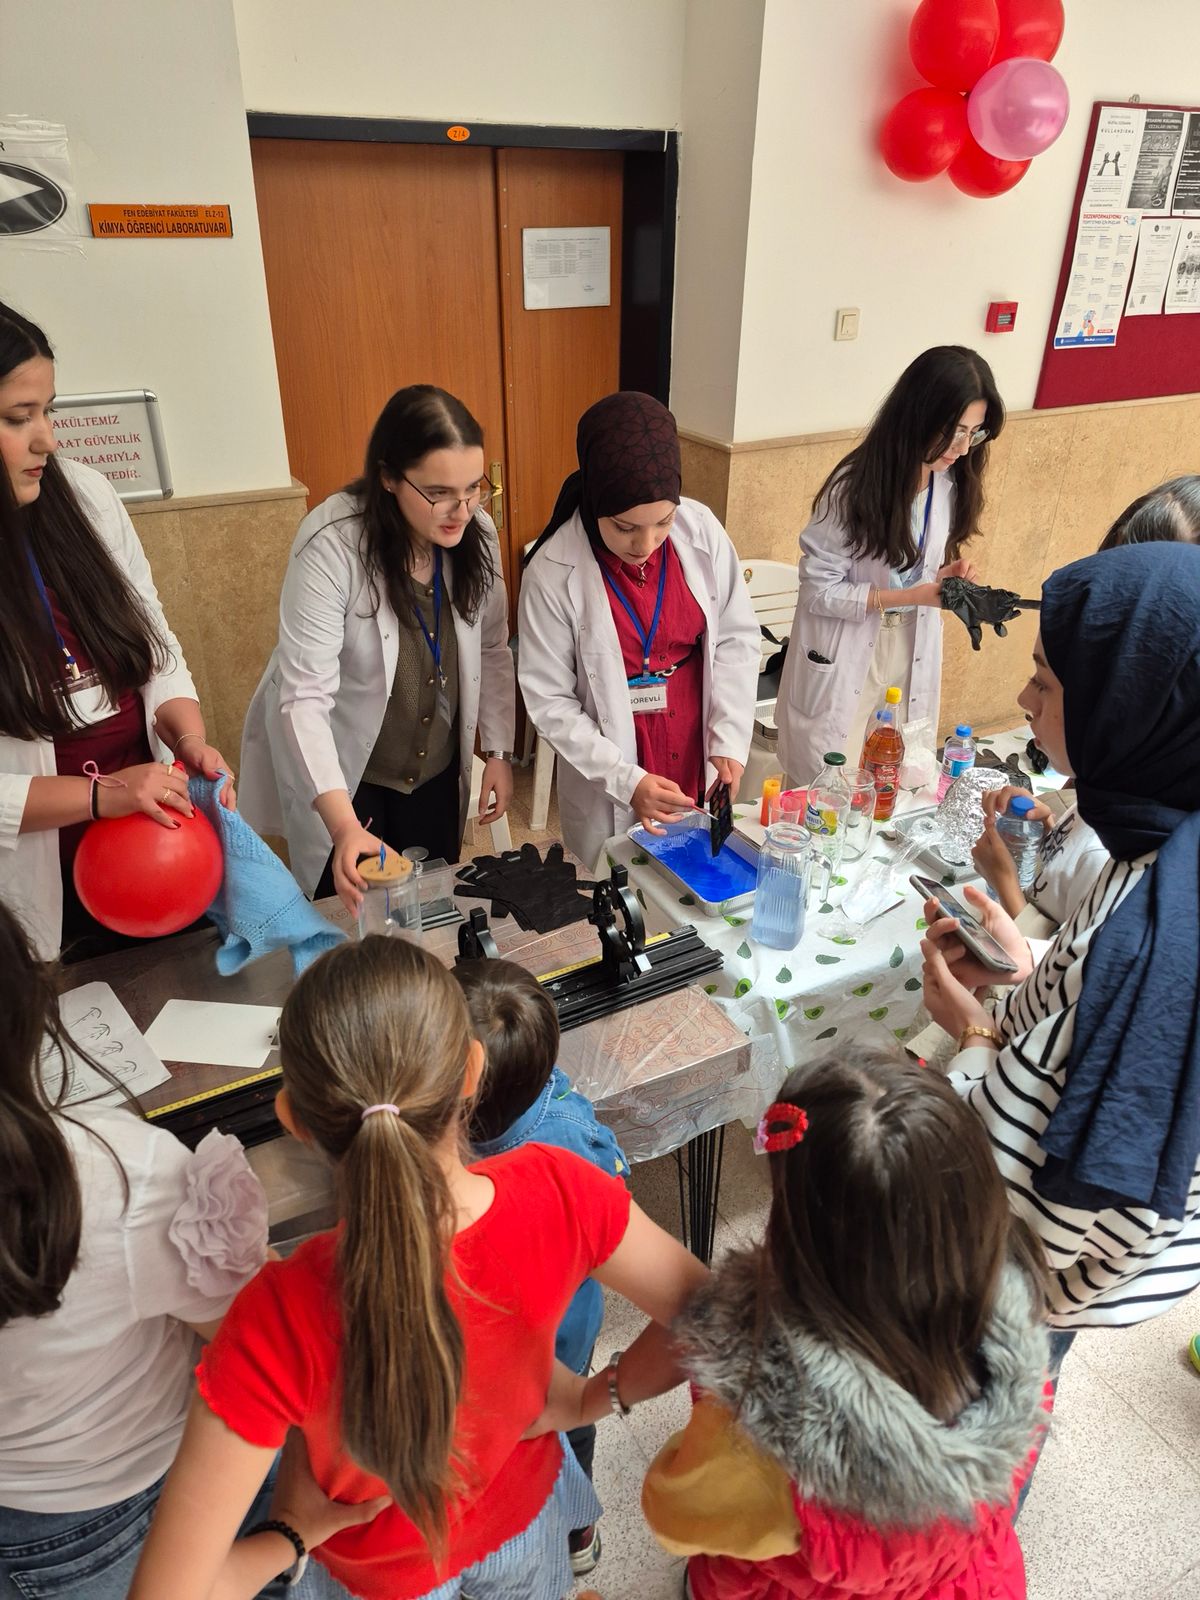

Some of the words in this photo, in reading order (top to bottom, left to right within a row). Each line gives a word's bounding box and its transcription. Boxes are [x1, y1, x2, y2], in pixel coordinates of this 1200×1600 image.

[123, 209, 136, 217] FEN
[136, 208, 165, 218] EDEBİYAT
[166, 208, 199, 218] FAKÜLTESİ
[99, 220, 125, 234] KİMYA
[126, 219, 165, 234] ÖĞRENCİ
[166, 221, 227, 234] LABORATUVARI
[52, 414, 120, 429] AKÜLTEMİZ
[57, 438, 81, 449] AAT
[84, 432, 142, 447] GÜVENLİK
[103, 468, 141, 481] TEDİR.
